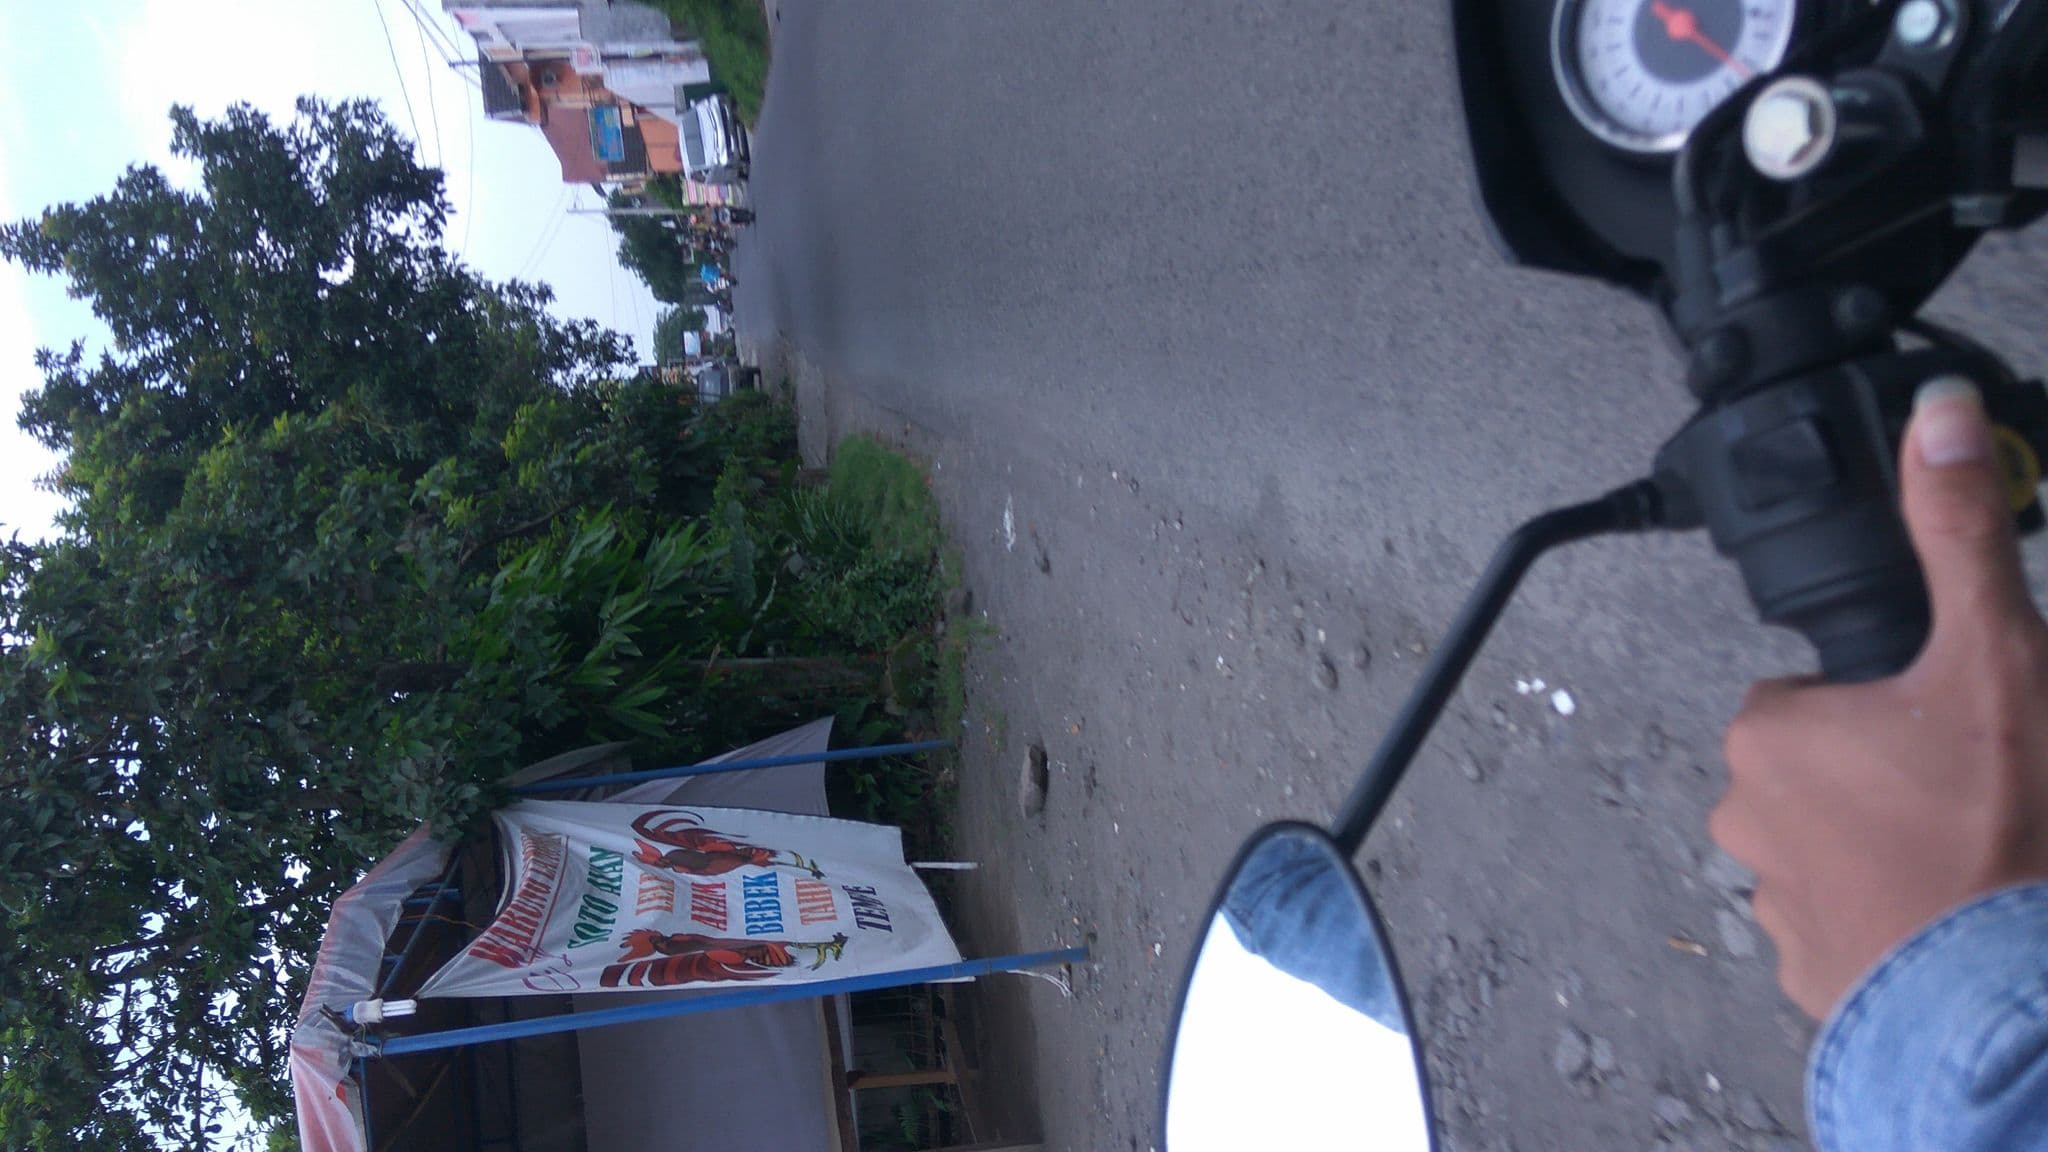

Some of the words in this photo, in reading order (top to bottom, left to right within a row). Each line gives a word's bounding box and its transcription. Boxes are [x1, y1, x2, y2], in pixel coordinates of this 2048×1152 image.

[469, 876, 552, 968] WARUNG
[567, 894, 619, 949] SOTO
[690, 882, 728, 931] AYAM
[743, 871, 785, 936] BEBEK
[795, 878, 838, 925] TAHU
